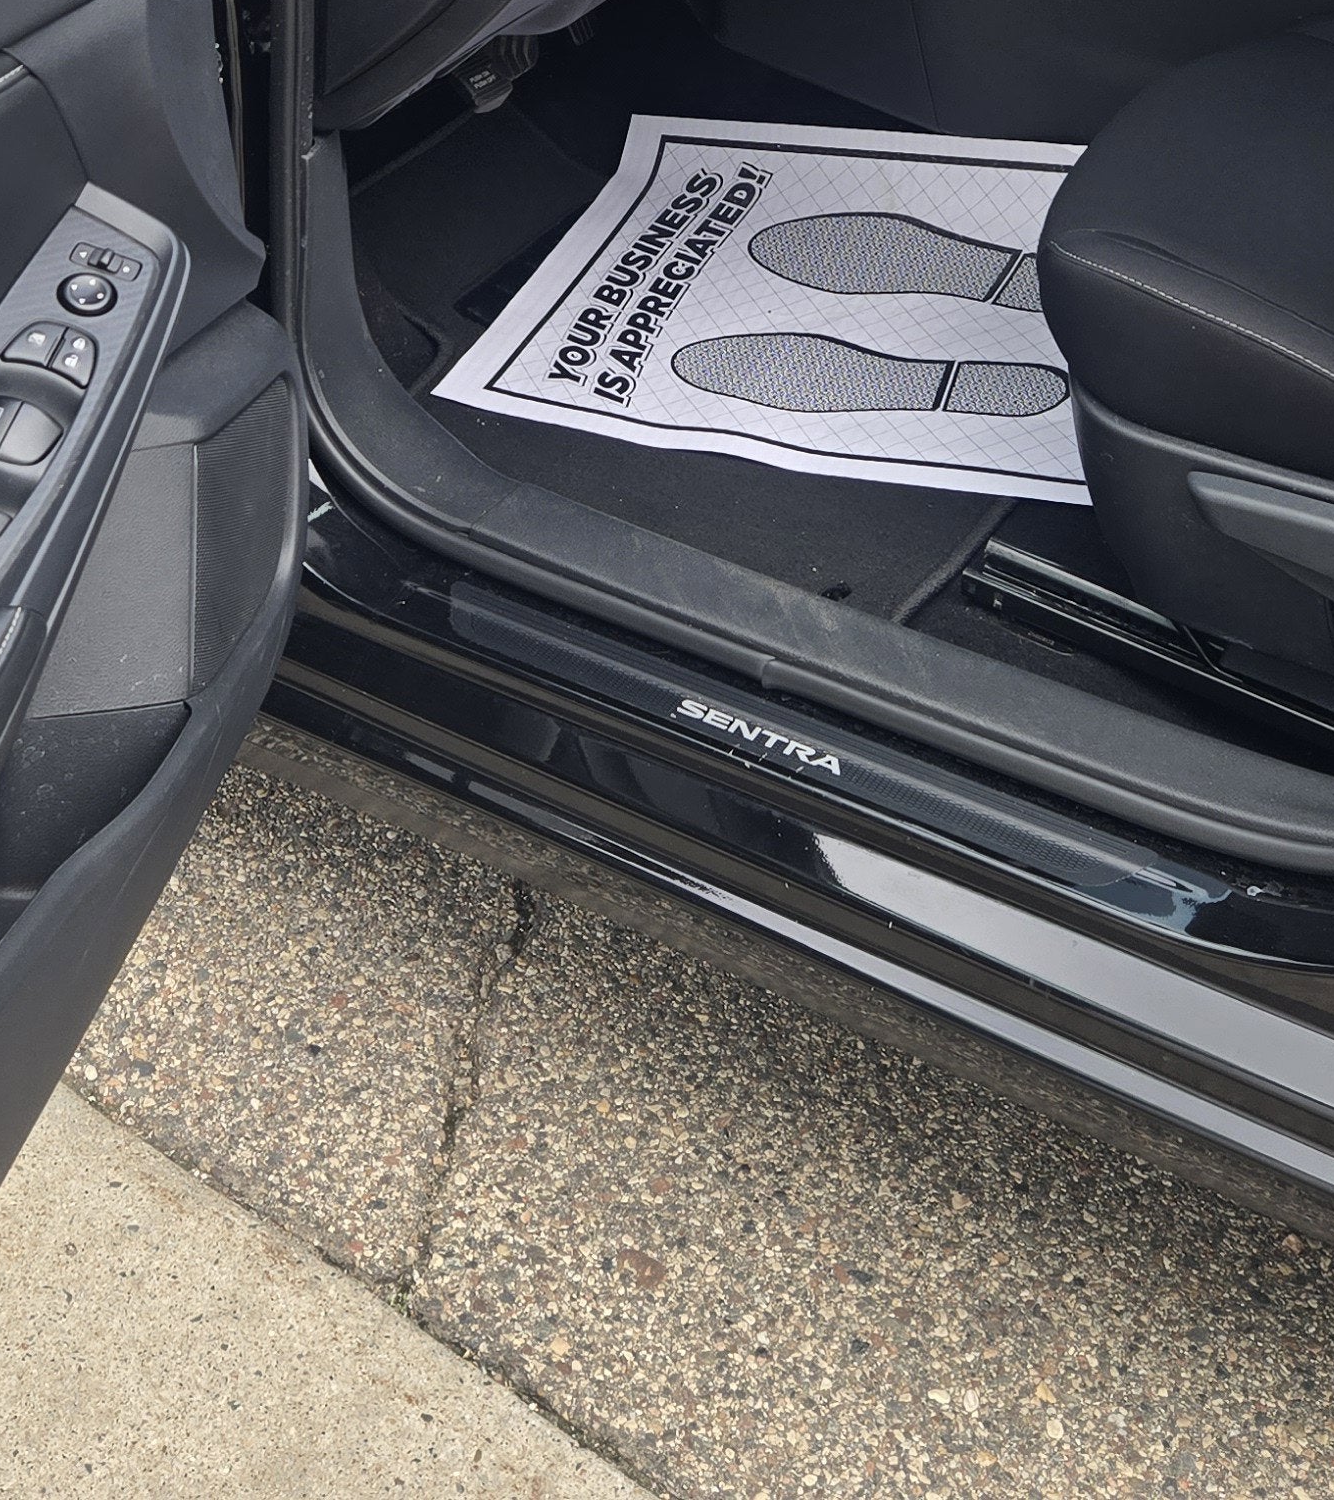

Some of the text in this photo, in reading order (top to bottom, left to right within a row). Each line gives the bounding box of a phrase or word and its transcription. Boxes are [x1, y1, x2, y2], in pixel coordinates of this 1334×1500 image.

[547, 169, 722, 385] YOUR BUSINESS
[593, 162, 773, 407] IS APPRECIATED!
[676, 698, 842, 776] SENTRA
